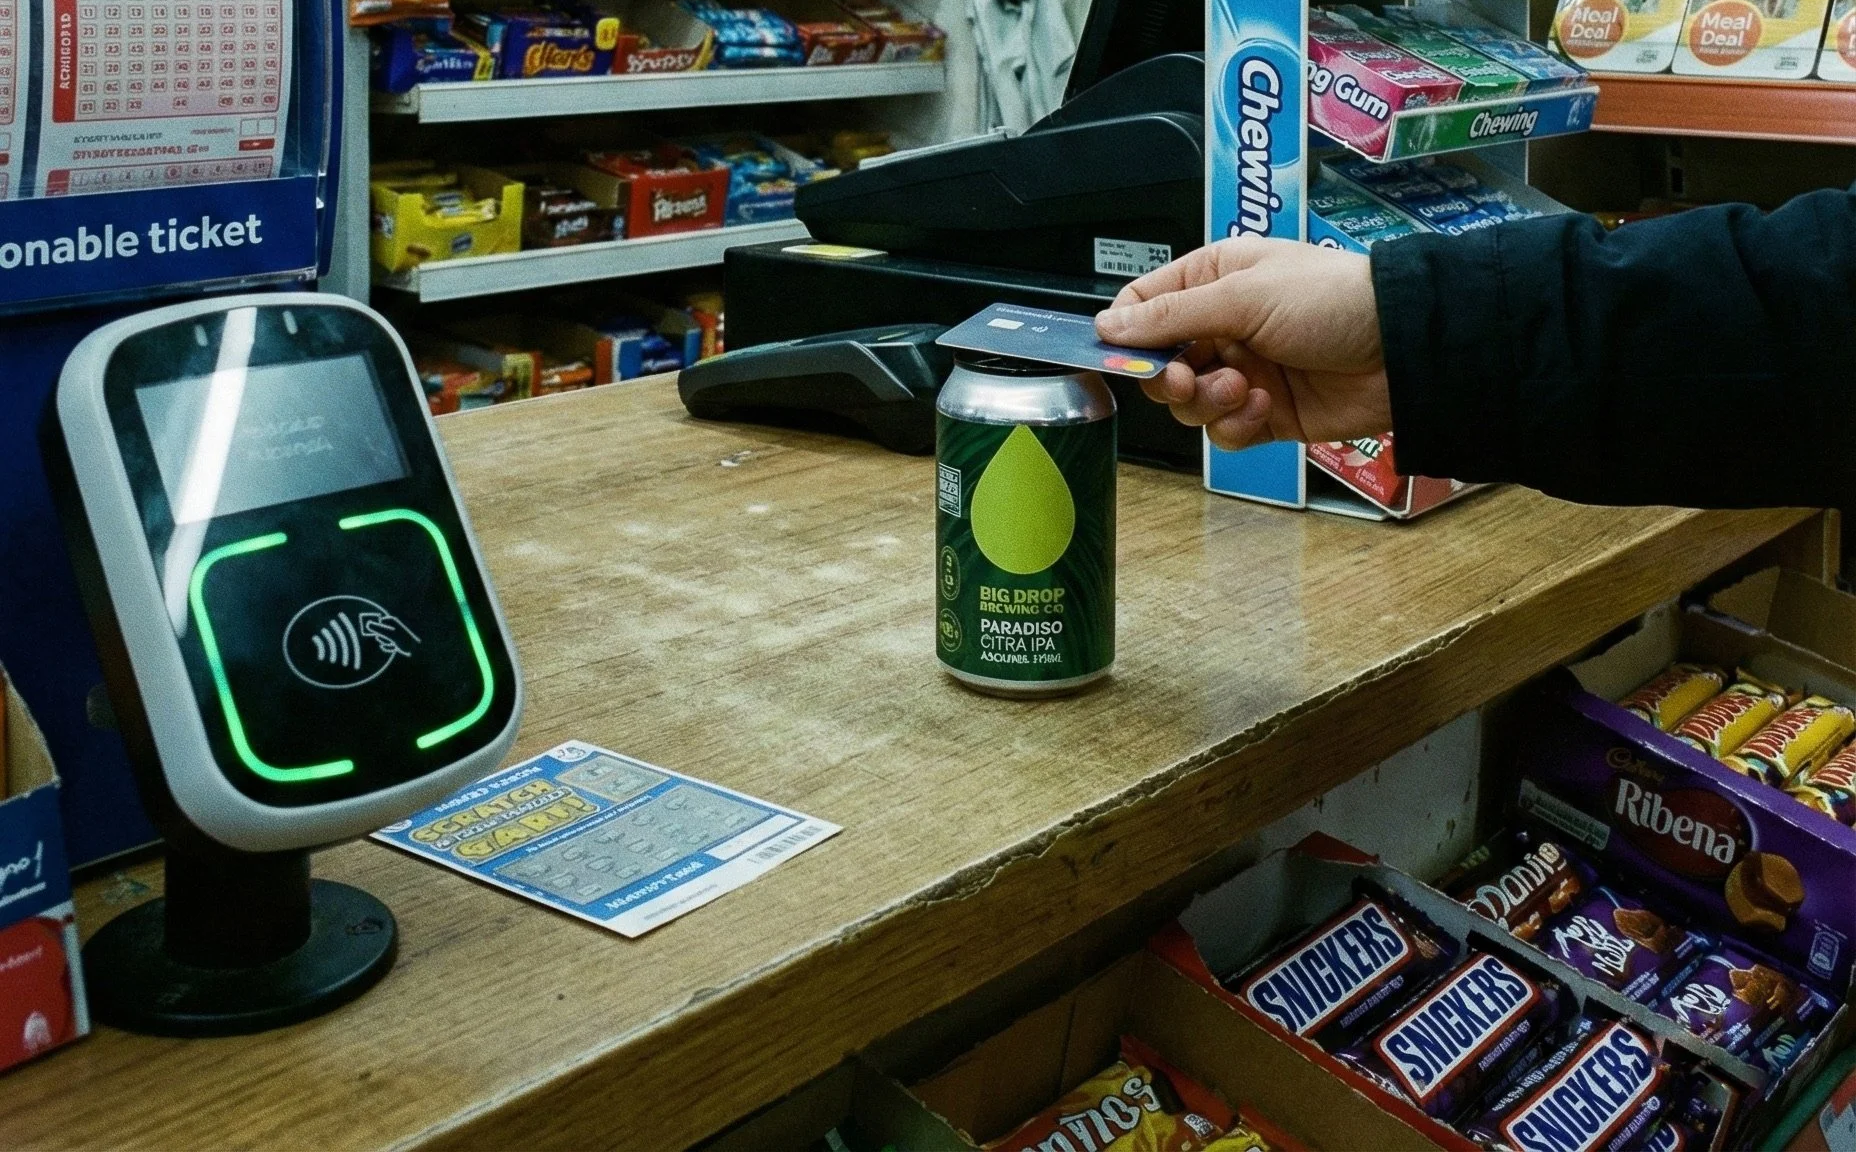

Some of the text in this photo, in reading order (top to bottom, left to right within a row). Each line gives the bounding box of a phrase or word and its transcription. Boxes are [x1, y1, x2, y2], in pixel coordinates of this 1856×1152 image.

[1701, 30, 1745, 46] Deal
[1702, 12, 1754, 30] Meal
[1334, 75, 1390, 120] Gum
[1469, 107, 1539, 138] Chewing
[0, 214, 263, 269] onable ticket
[980, 585, 1065, 604] BIG DROP
[980, 618, 1063, 635] PARADISO
[980, 633, 1056, 652] CITRA IPA
[411, 779, 557, 844] SCRATCH
[1615, 778, 1736, 864] Ribena
[1252, 906, 1405, 1034] SNICKERS
[1386, 957, 1529, 1088] SNICKERS
[1512, 1027, 1653, 1152] SNICKERS
